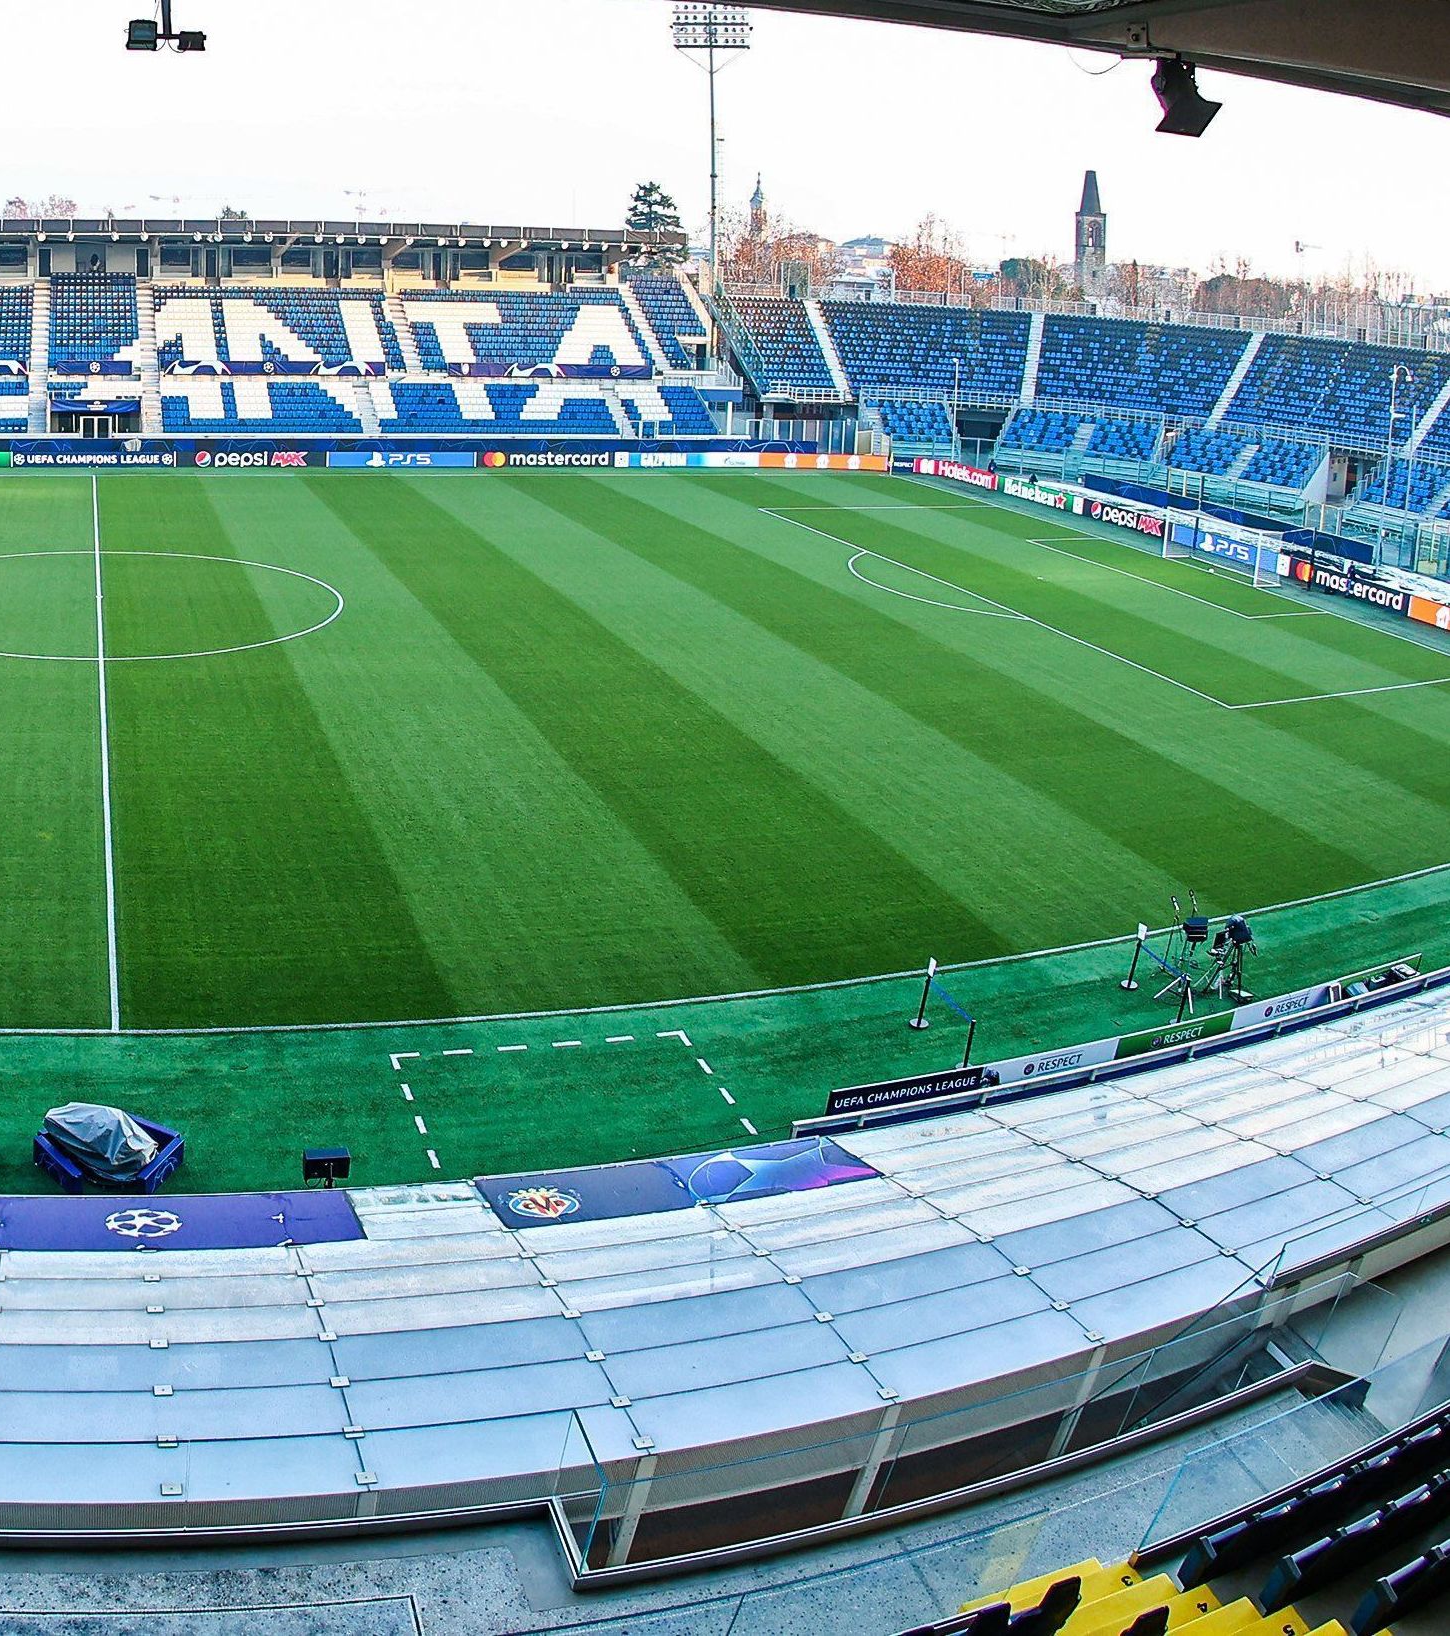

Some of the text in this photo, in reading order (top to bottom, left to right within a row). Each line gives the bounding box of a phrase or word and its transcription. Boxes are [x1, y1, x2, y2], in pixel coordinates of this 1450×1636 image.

[26, 454, 159, 464] UEFA CHAMPIONS LEAGUE
[214, 451, 308, 467] pepsi MAX
[509, 452, 609, 466] mastercard
[938, 461, 992, 489] Hotels.com
[1003, 478, 1054, 507] Heineken
[1102, 507, 1164, 537] pepsi MAX
[1214, 541, 1250, 561] PS5
[1274, 995, 1309, 1014] RESPECT
[1163, 1026, 1204, 1045] RESPECT
[1037, 1053, 1083, 1072] RESPECT
[834, 1076, 977, 1109] UEFA CHAMPIONS LEAGUE
[1120, 1575, 1134, 1587] 3
[1196, 1602, 1208, 1613] 4
[1282, 1624, 1295, 1636] 5
